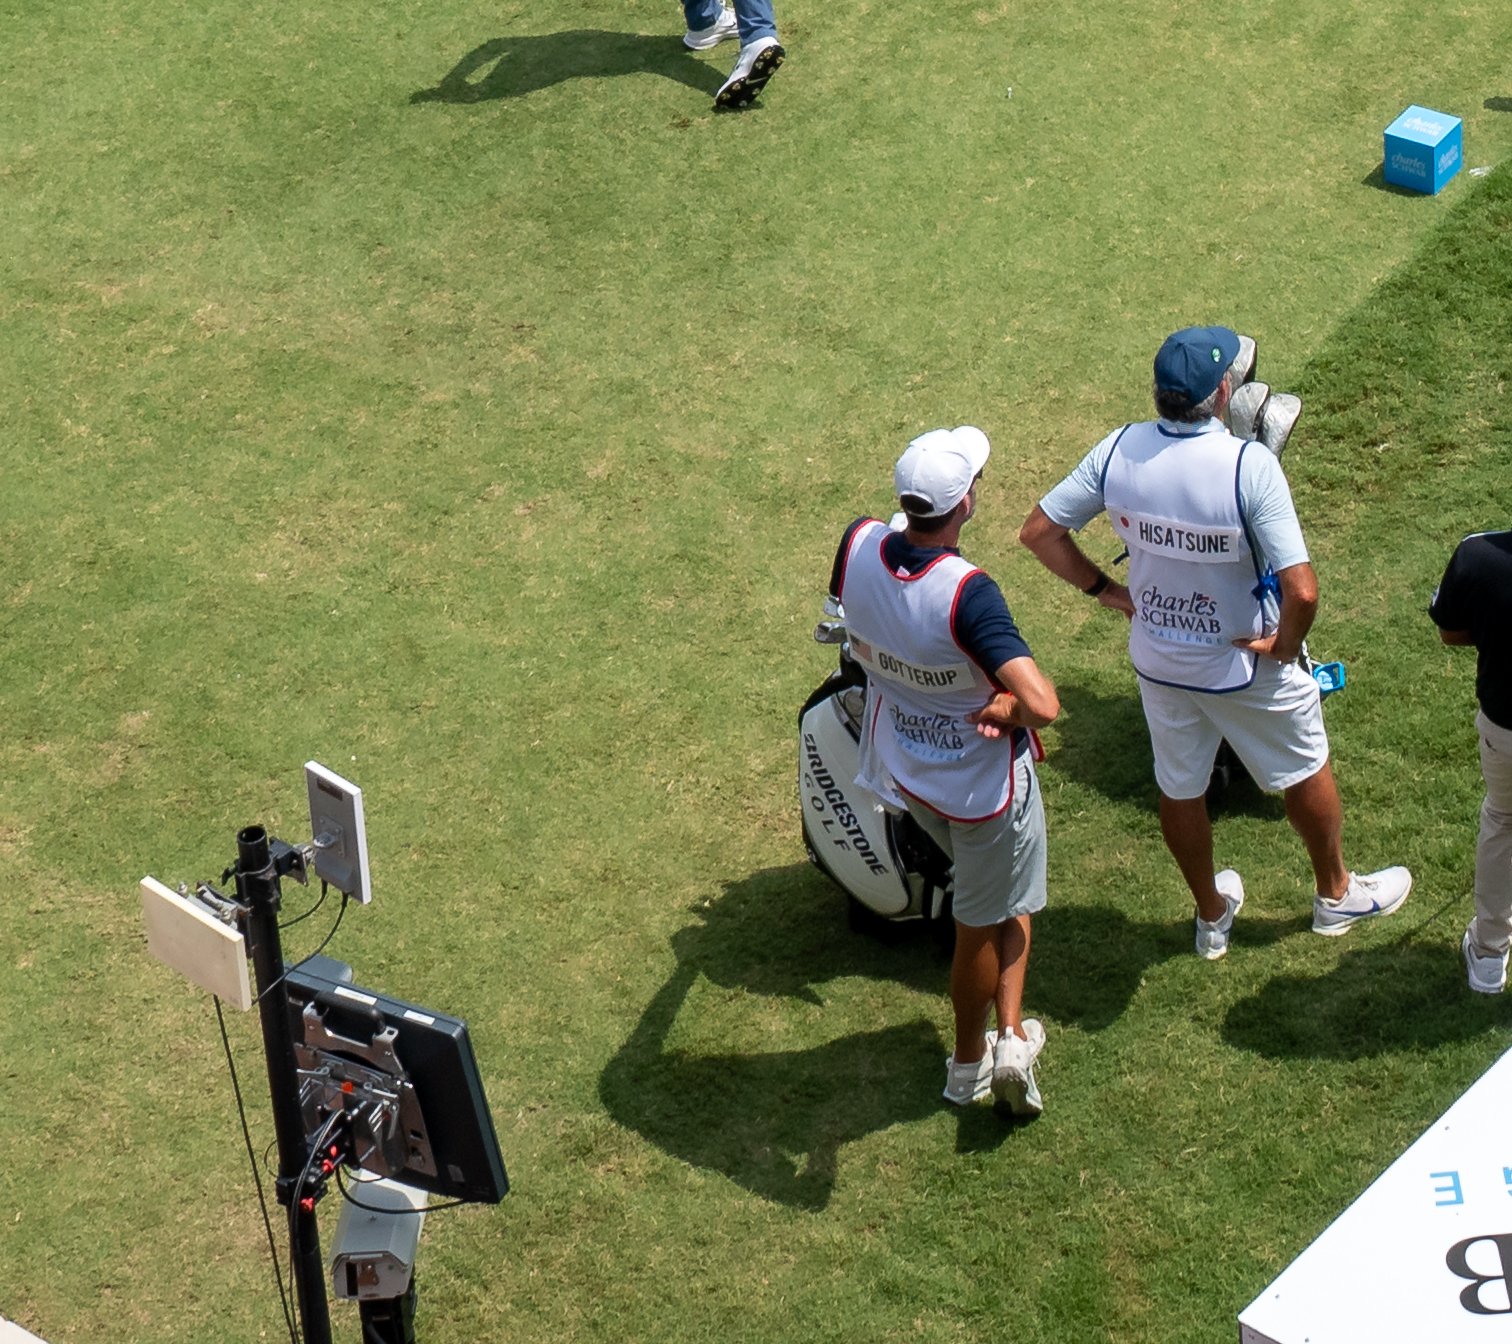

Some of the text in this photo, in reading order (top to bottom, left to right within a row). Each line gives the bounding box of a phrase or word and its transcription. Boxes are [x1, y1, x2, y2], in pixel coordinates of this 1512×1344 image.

[1139, 521, 1230, 554] HISATSUNE
[1141, 585, 1218, 617] charles
[1140, 606, 1222, 635] SCHWAB
[878, 651, 958, 687] GOTTERUP
[803, 732, 889, 877] BRIDGESTONE
[804, 771, 852, 852] GOLF
